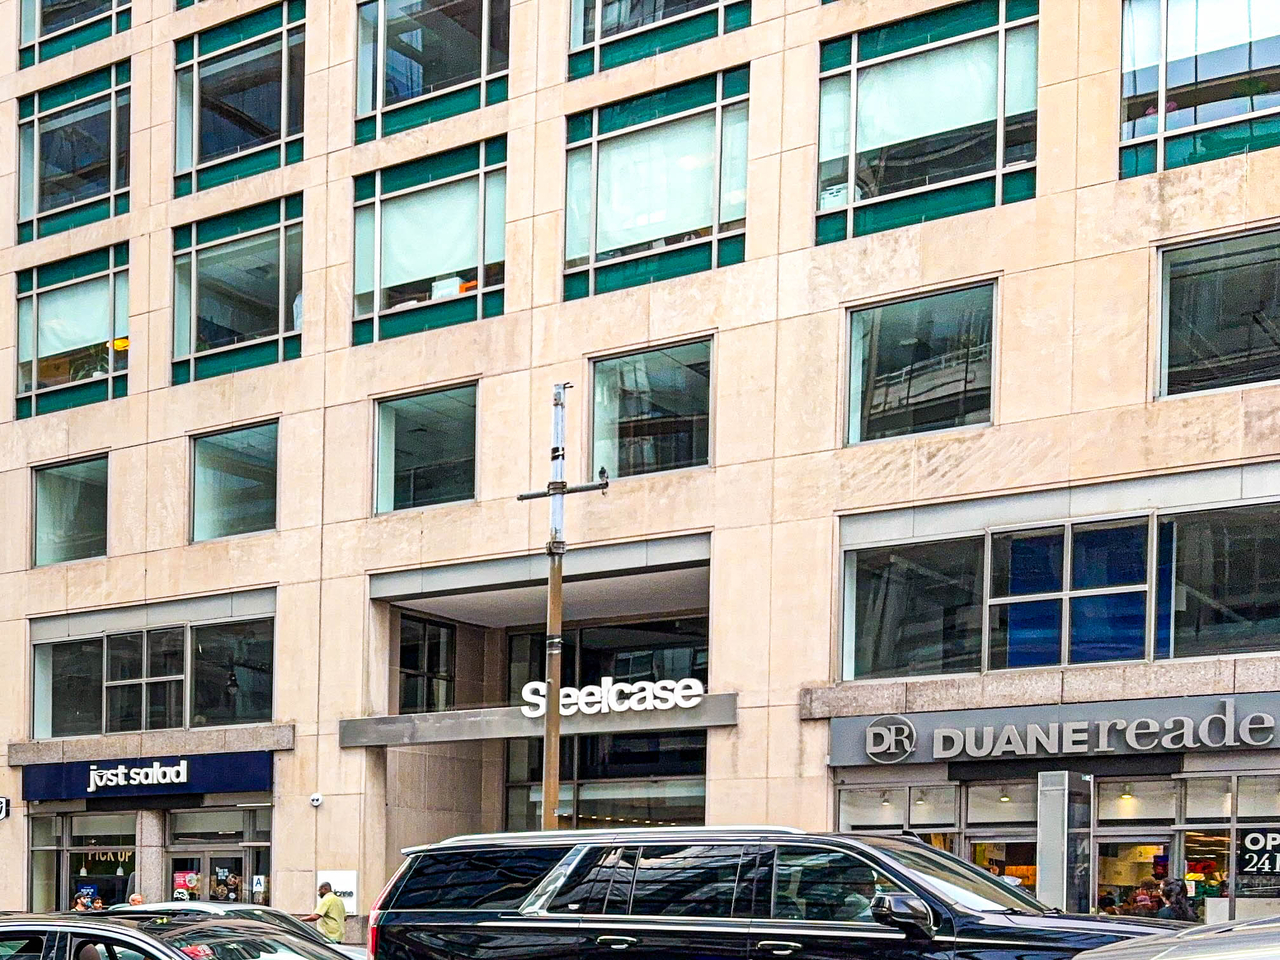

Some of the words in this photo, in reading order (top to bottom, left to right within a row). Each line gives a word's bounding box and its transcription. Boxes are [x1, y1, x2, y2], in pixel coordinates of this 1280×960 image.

[521, 677, 704, 718] Seelcase
[933, 721, 1089, 759] DUANE
[1093, 699, 1276, 752] reade
[86, 765, 128, 792] just
[129, 760, 188, 785] salad
[255, 879, 262, 888] A
